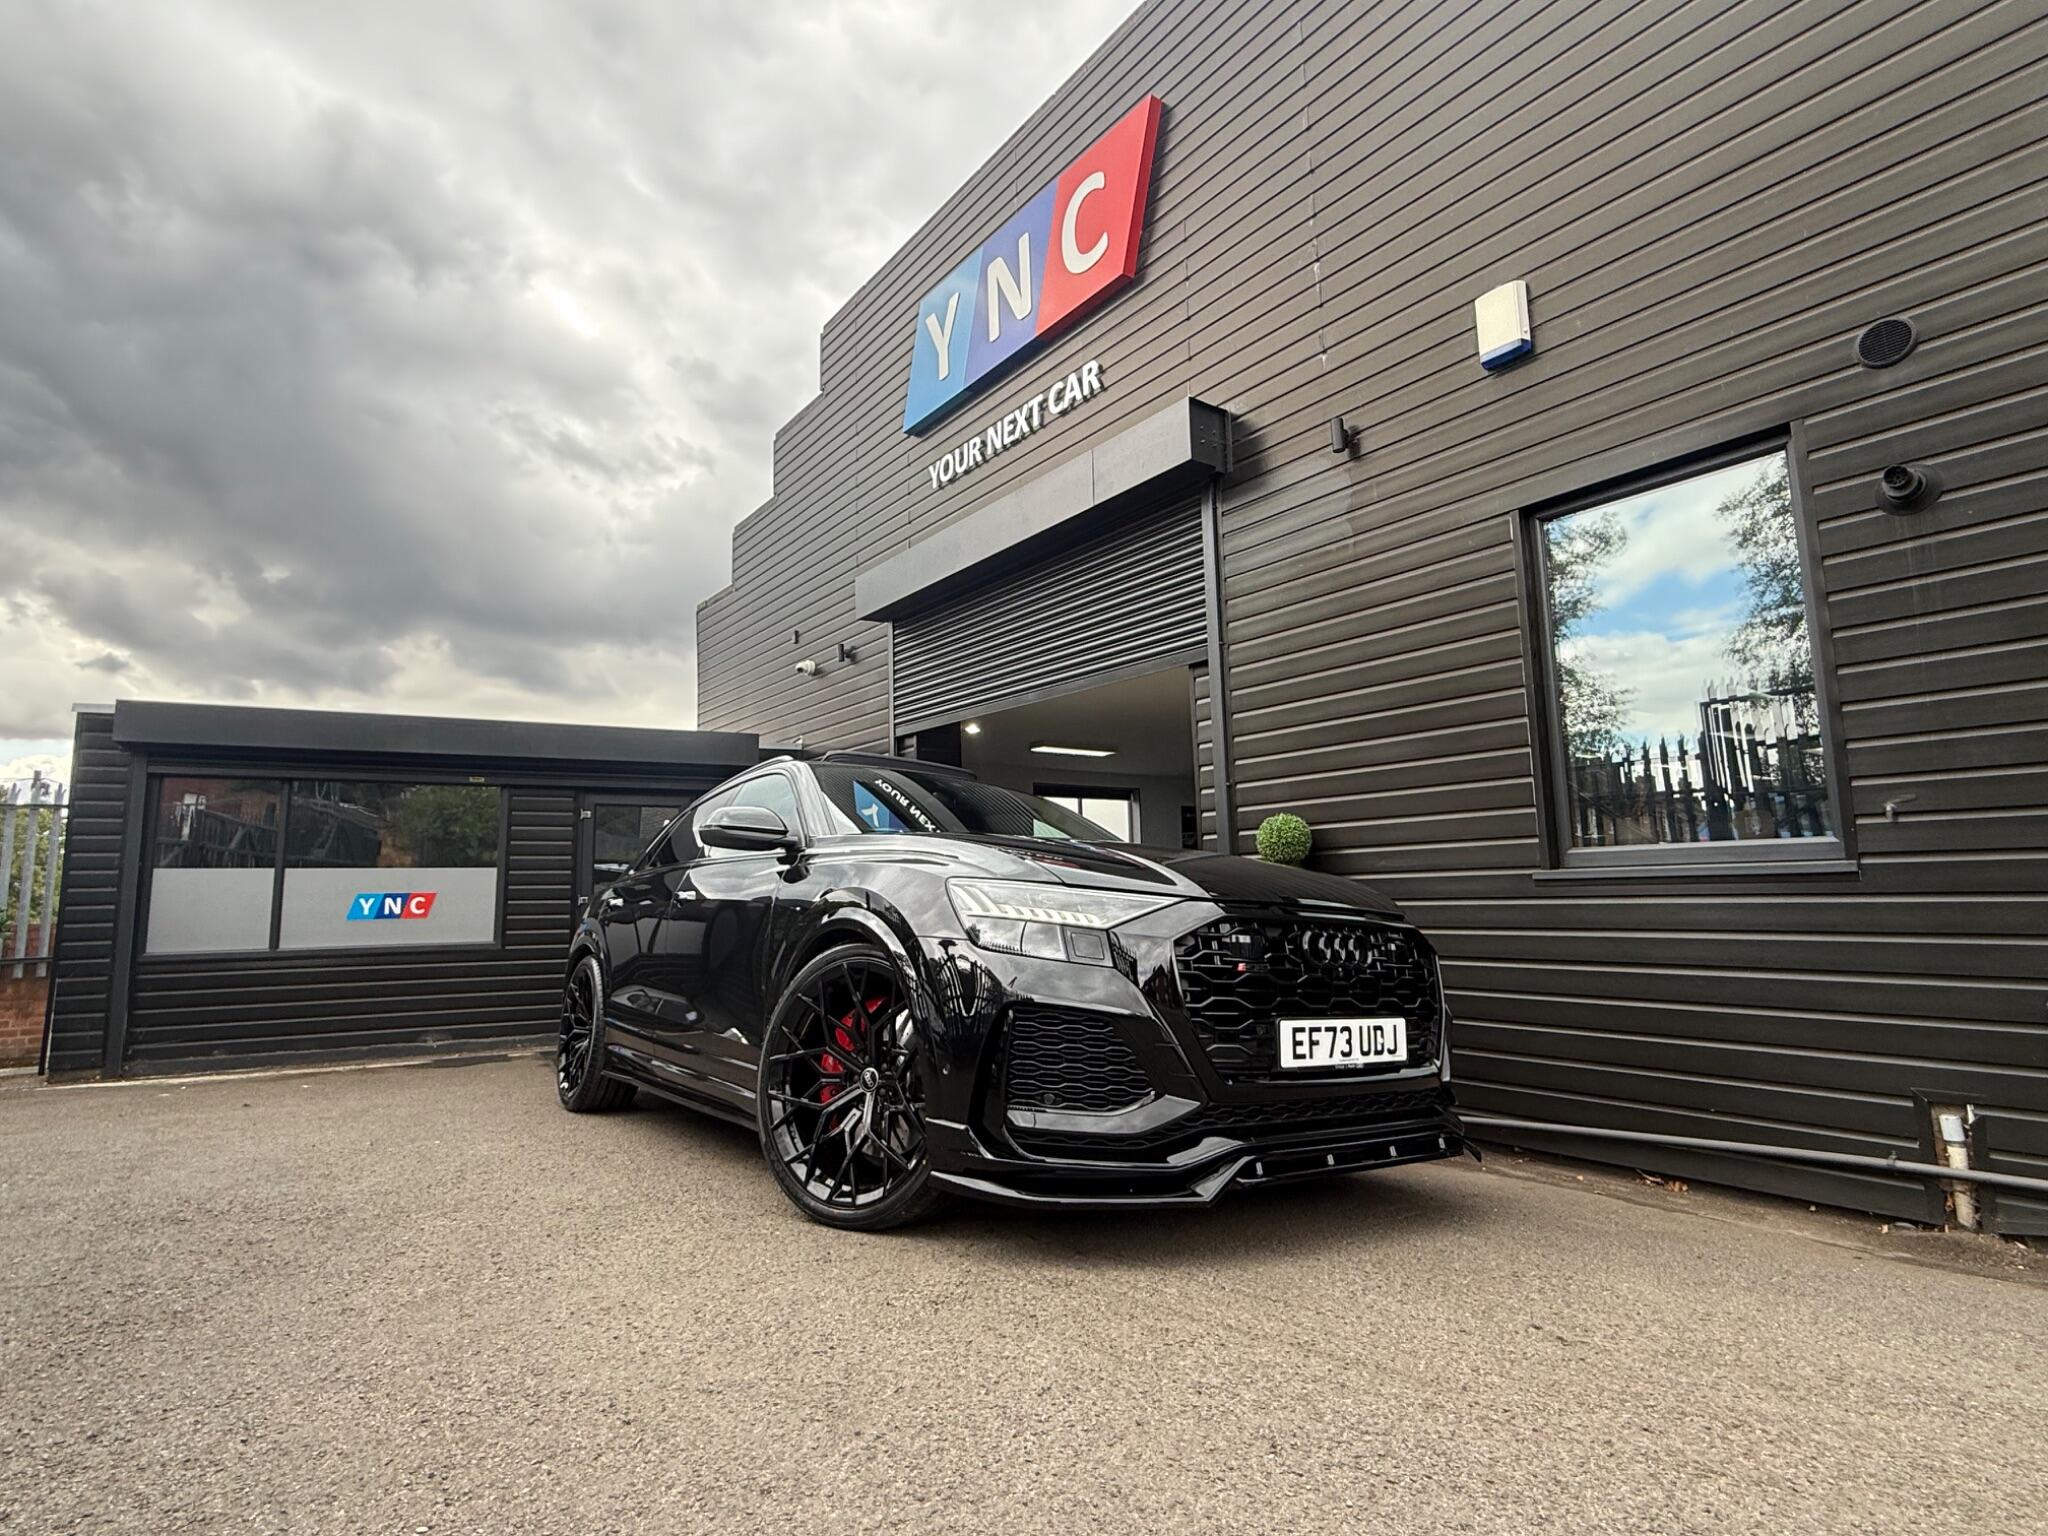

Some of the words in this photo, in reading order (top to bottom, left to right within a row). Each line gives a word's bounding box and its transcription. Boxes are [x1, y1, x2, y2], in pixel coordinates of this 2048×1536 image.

[925, 171, 1109, 381] YNC
[928, 437, 982, 489] YOUR
[986, 393, 1043, 456] NEXT
[1048, 360, 1100, 414] CAR
[359, 897, 426, 915] YNC
[1292, 1026, 1352, 1060] EF73
[1359, 1024, 1397, 1057] UDJ
